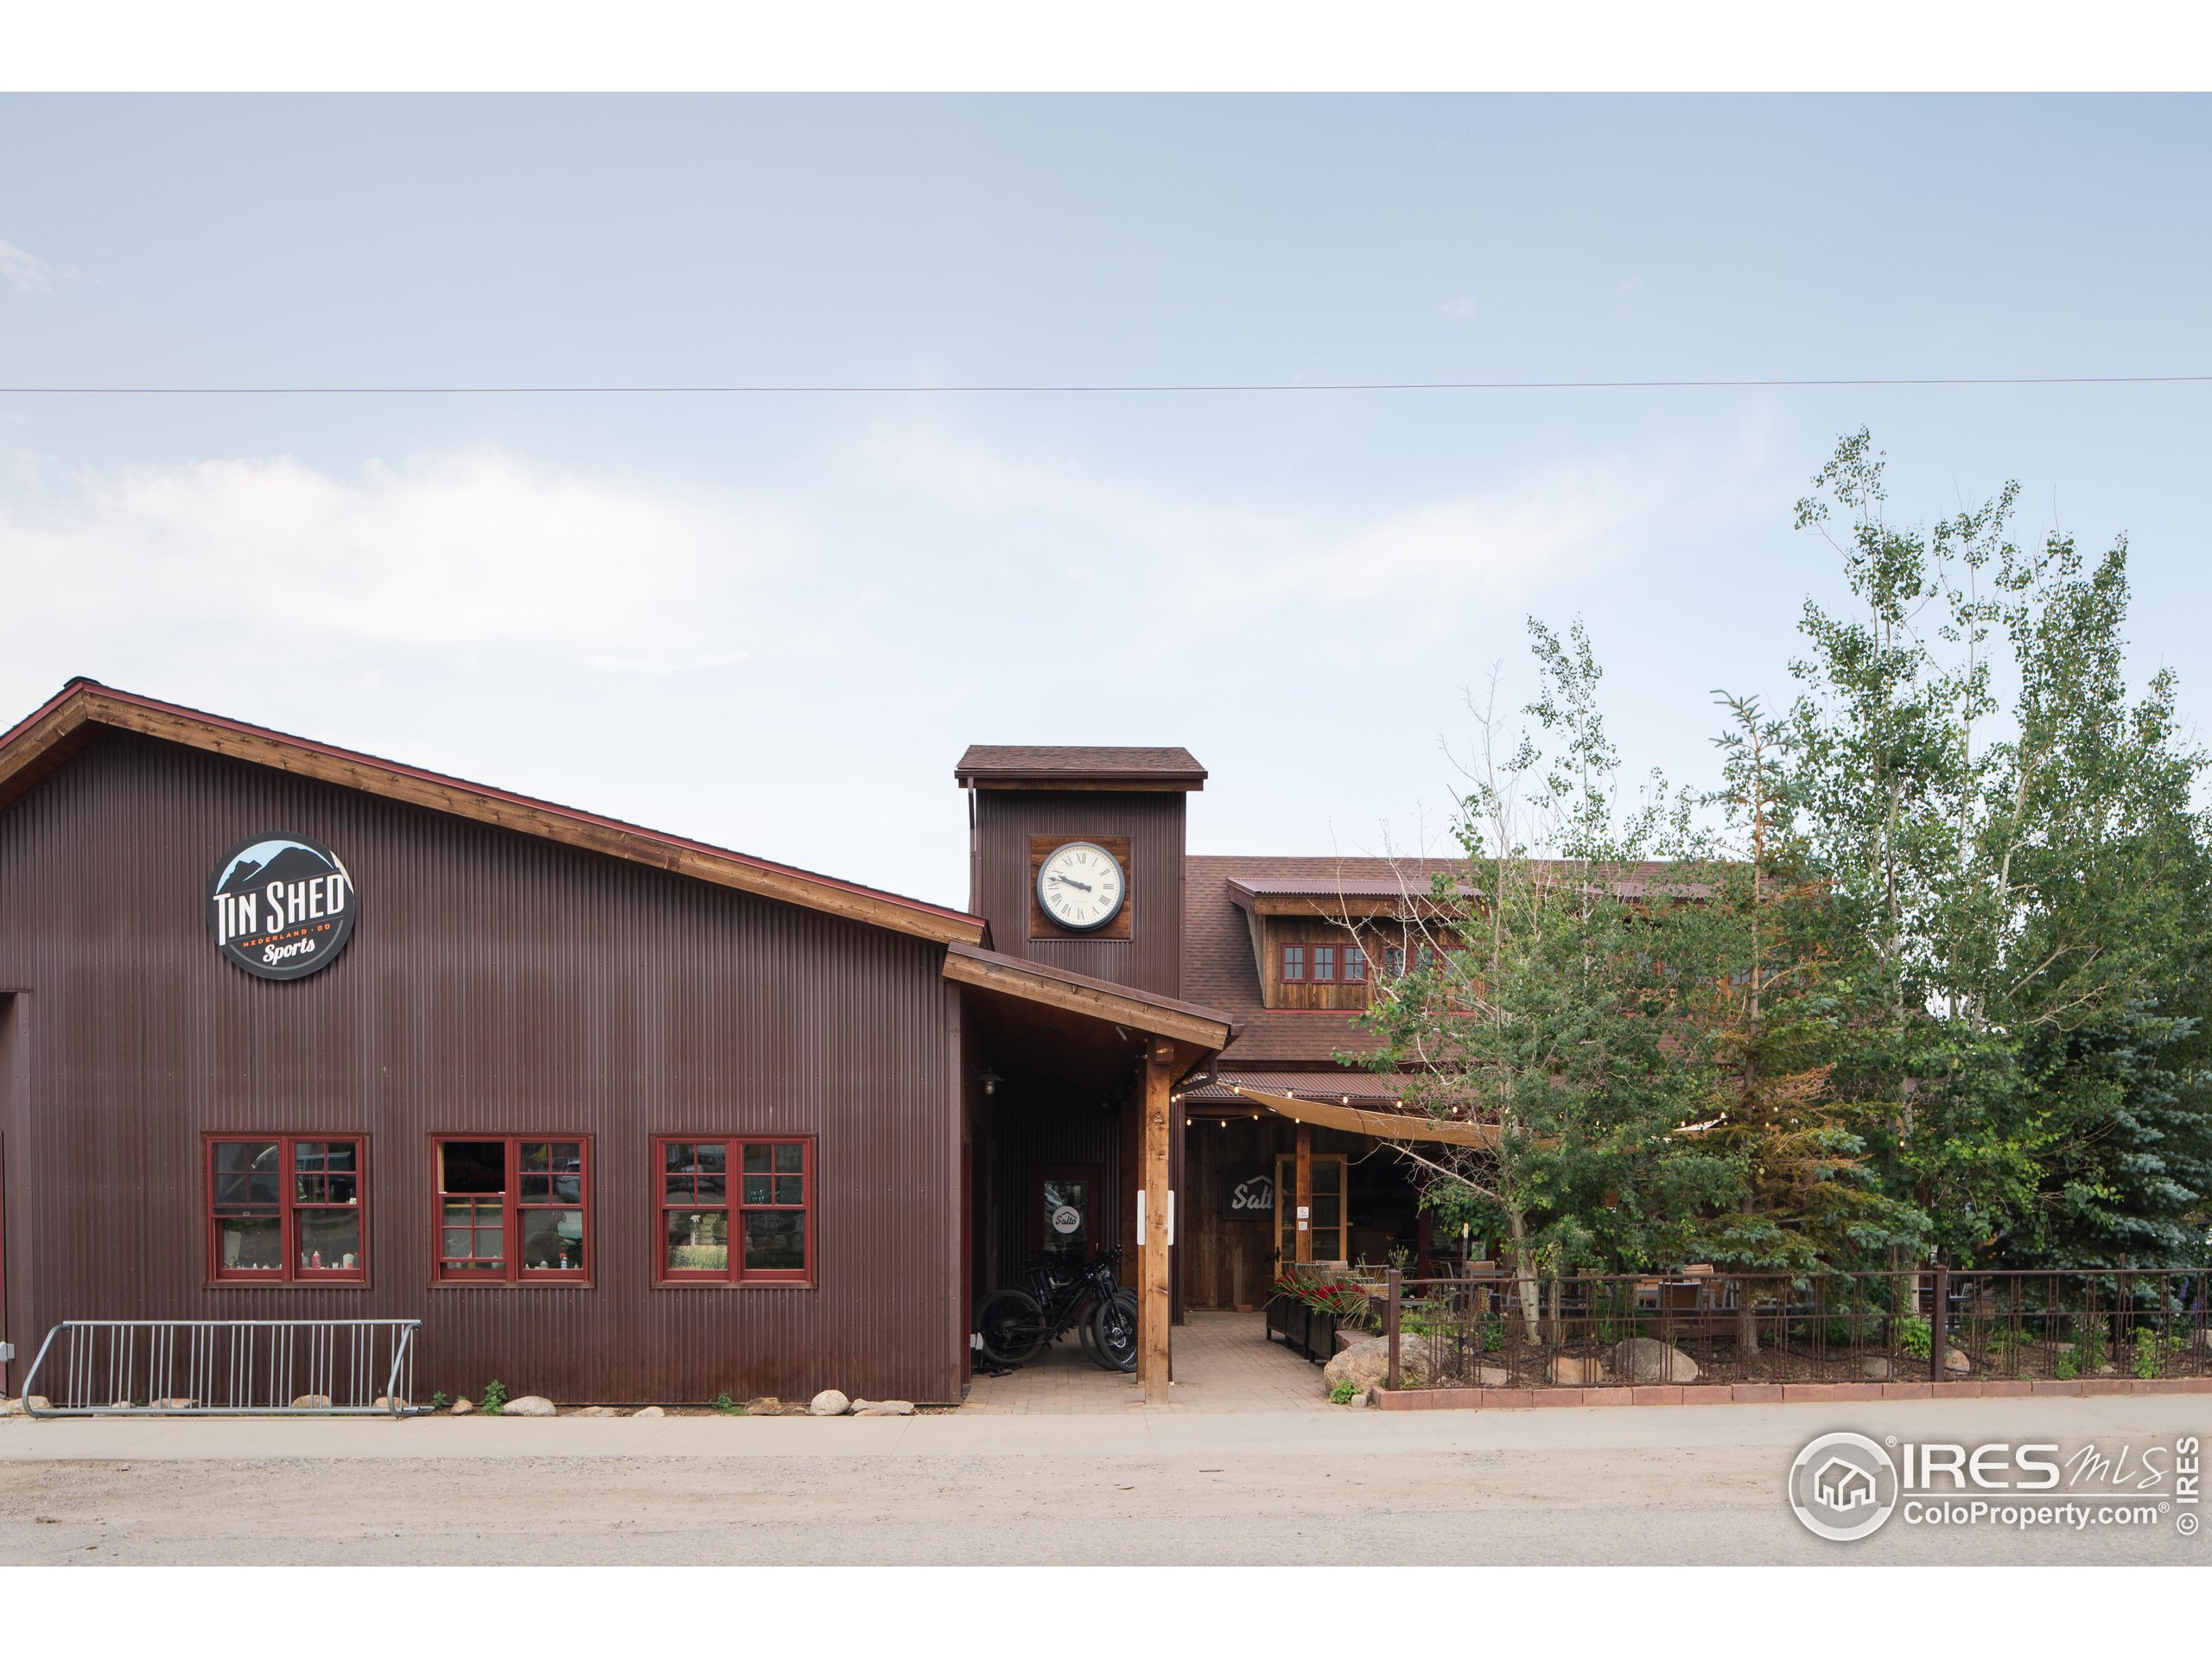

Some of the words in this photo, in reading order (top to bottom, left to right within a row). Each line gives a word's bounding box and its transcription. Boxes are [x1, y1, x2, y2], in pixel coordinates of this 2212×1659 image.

[213, 892, 257, 946] TIN
[266, 874, 345, 934] SHED
[243, 928, 308, 948] NEDERLAND
[316, 923, 332, 932] CO
[263, 938, 315, 966] Sports
[1231, 1183, 1286, 1210] Salt
[1055, 1214, 1077, 1225] Salto
